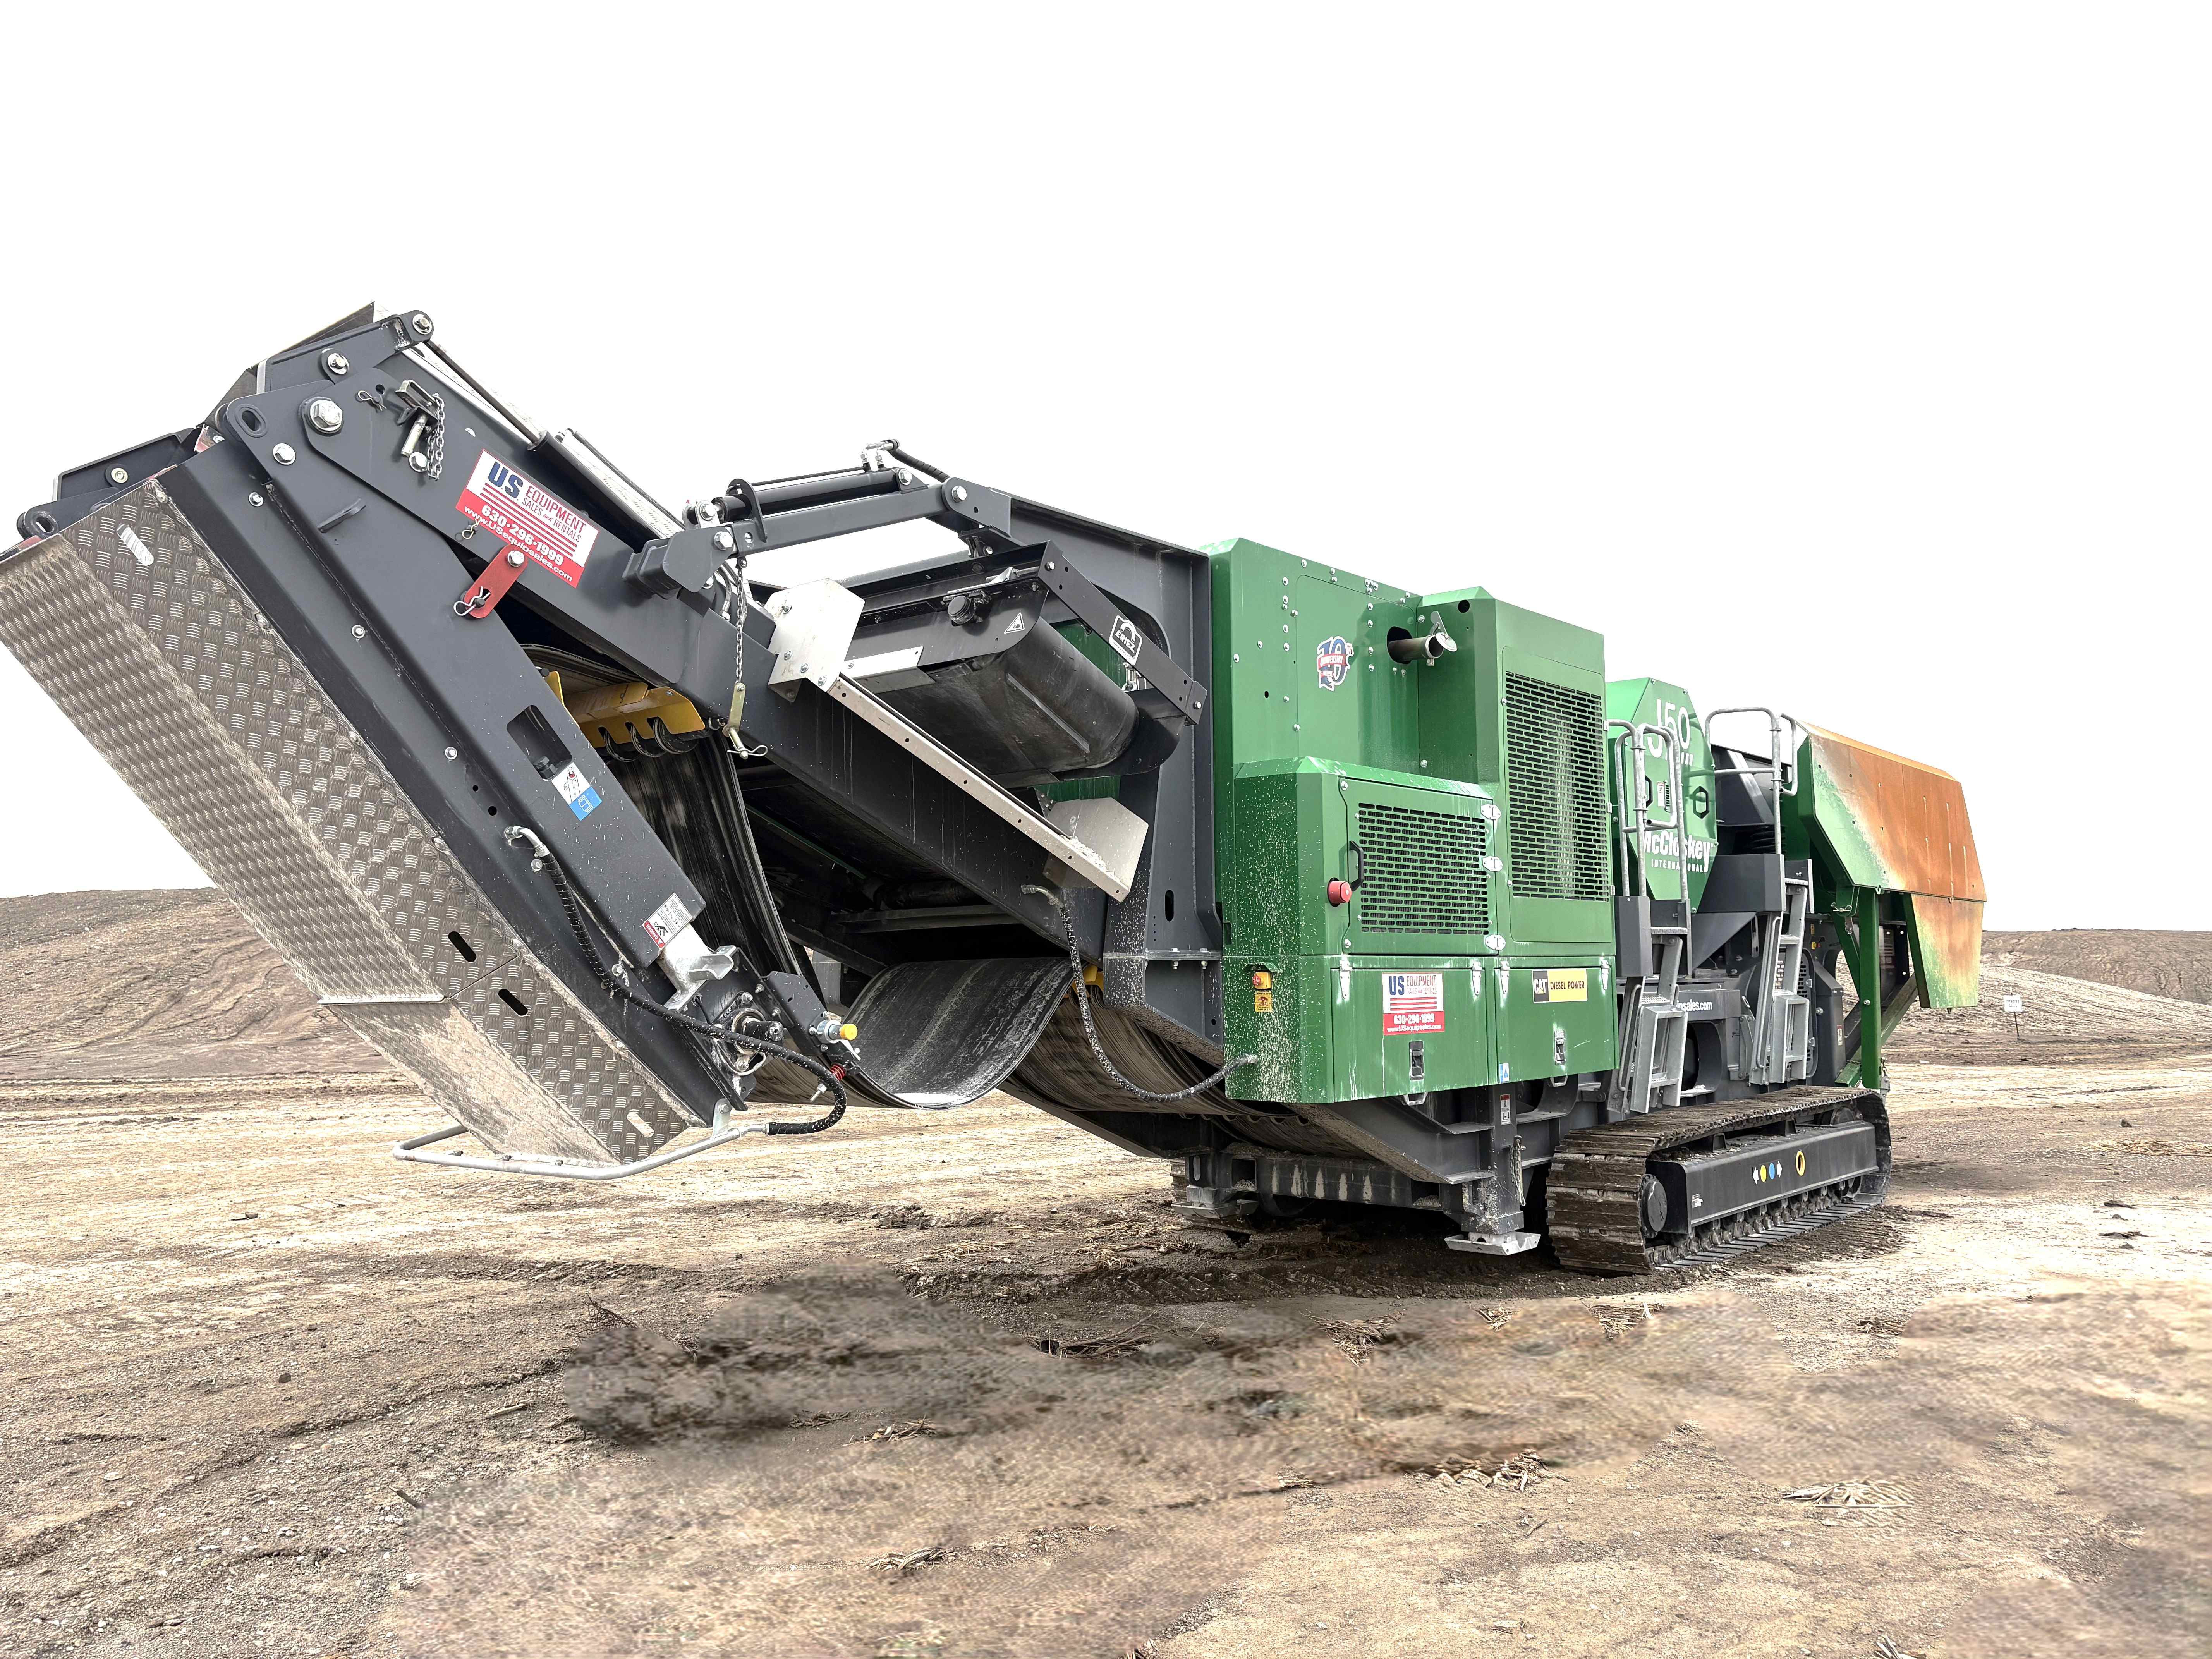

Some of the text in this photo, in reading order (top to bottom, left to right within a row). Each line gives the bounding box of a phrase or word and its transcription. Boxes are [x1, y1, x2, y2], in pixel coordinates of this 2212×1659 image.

[522, 498, 543, 516] SALES
[553, 519, 581, 542] RENTALS
[526, 486, 586, 533] EQUIPMENT
[1115, 630, 1135, 653] ERIEZ
[646, 924, 658, 940] DANGER
[1389, 975, 1436, 995] US EQUIPMENT
[1534, 979, 1585, 994] CAT DIESEL POWER
